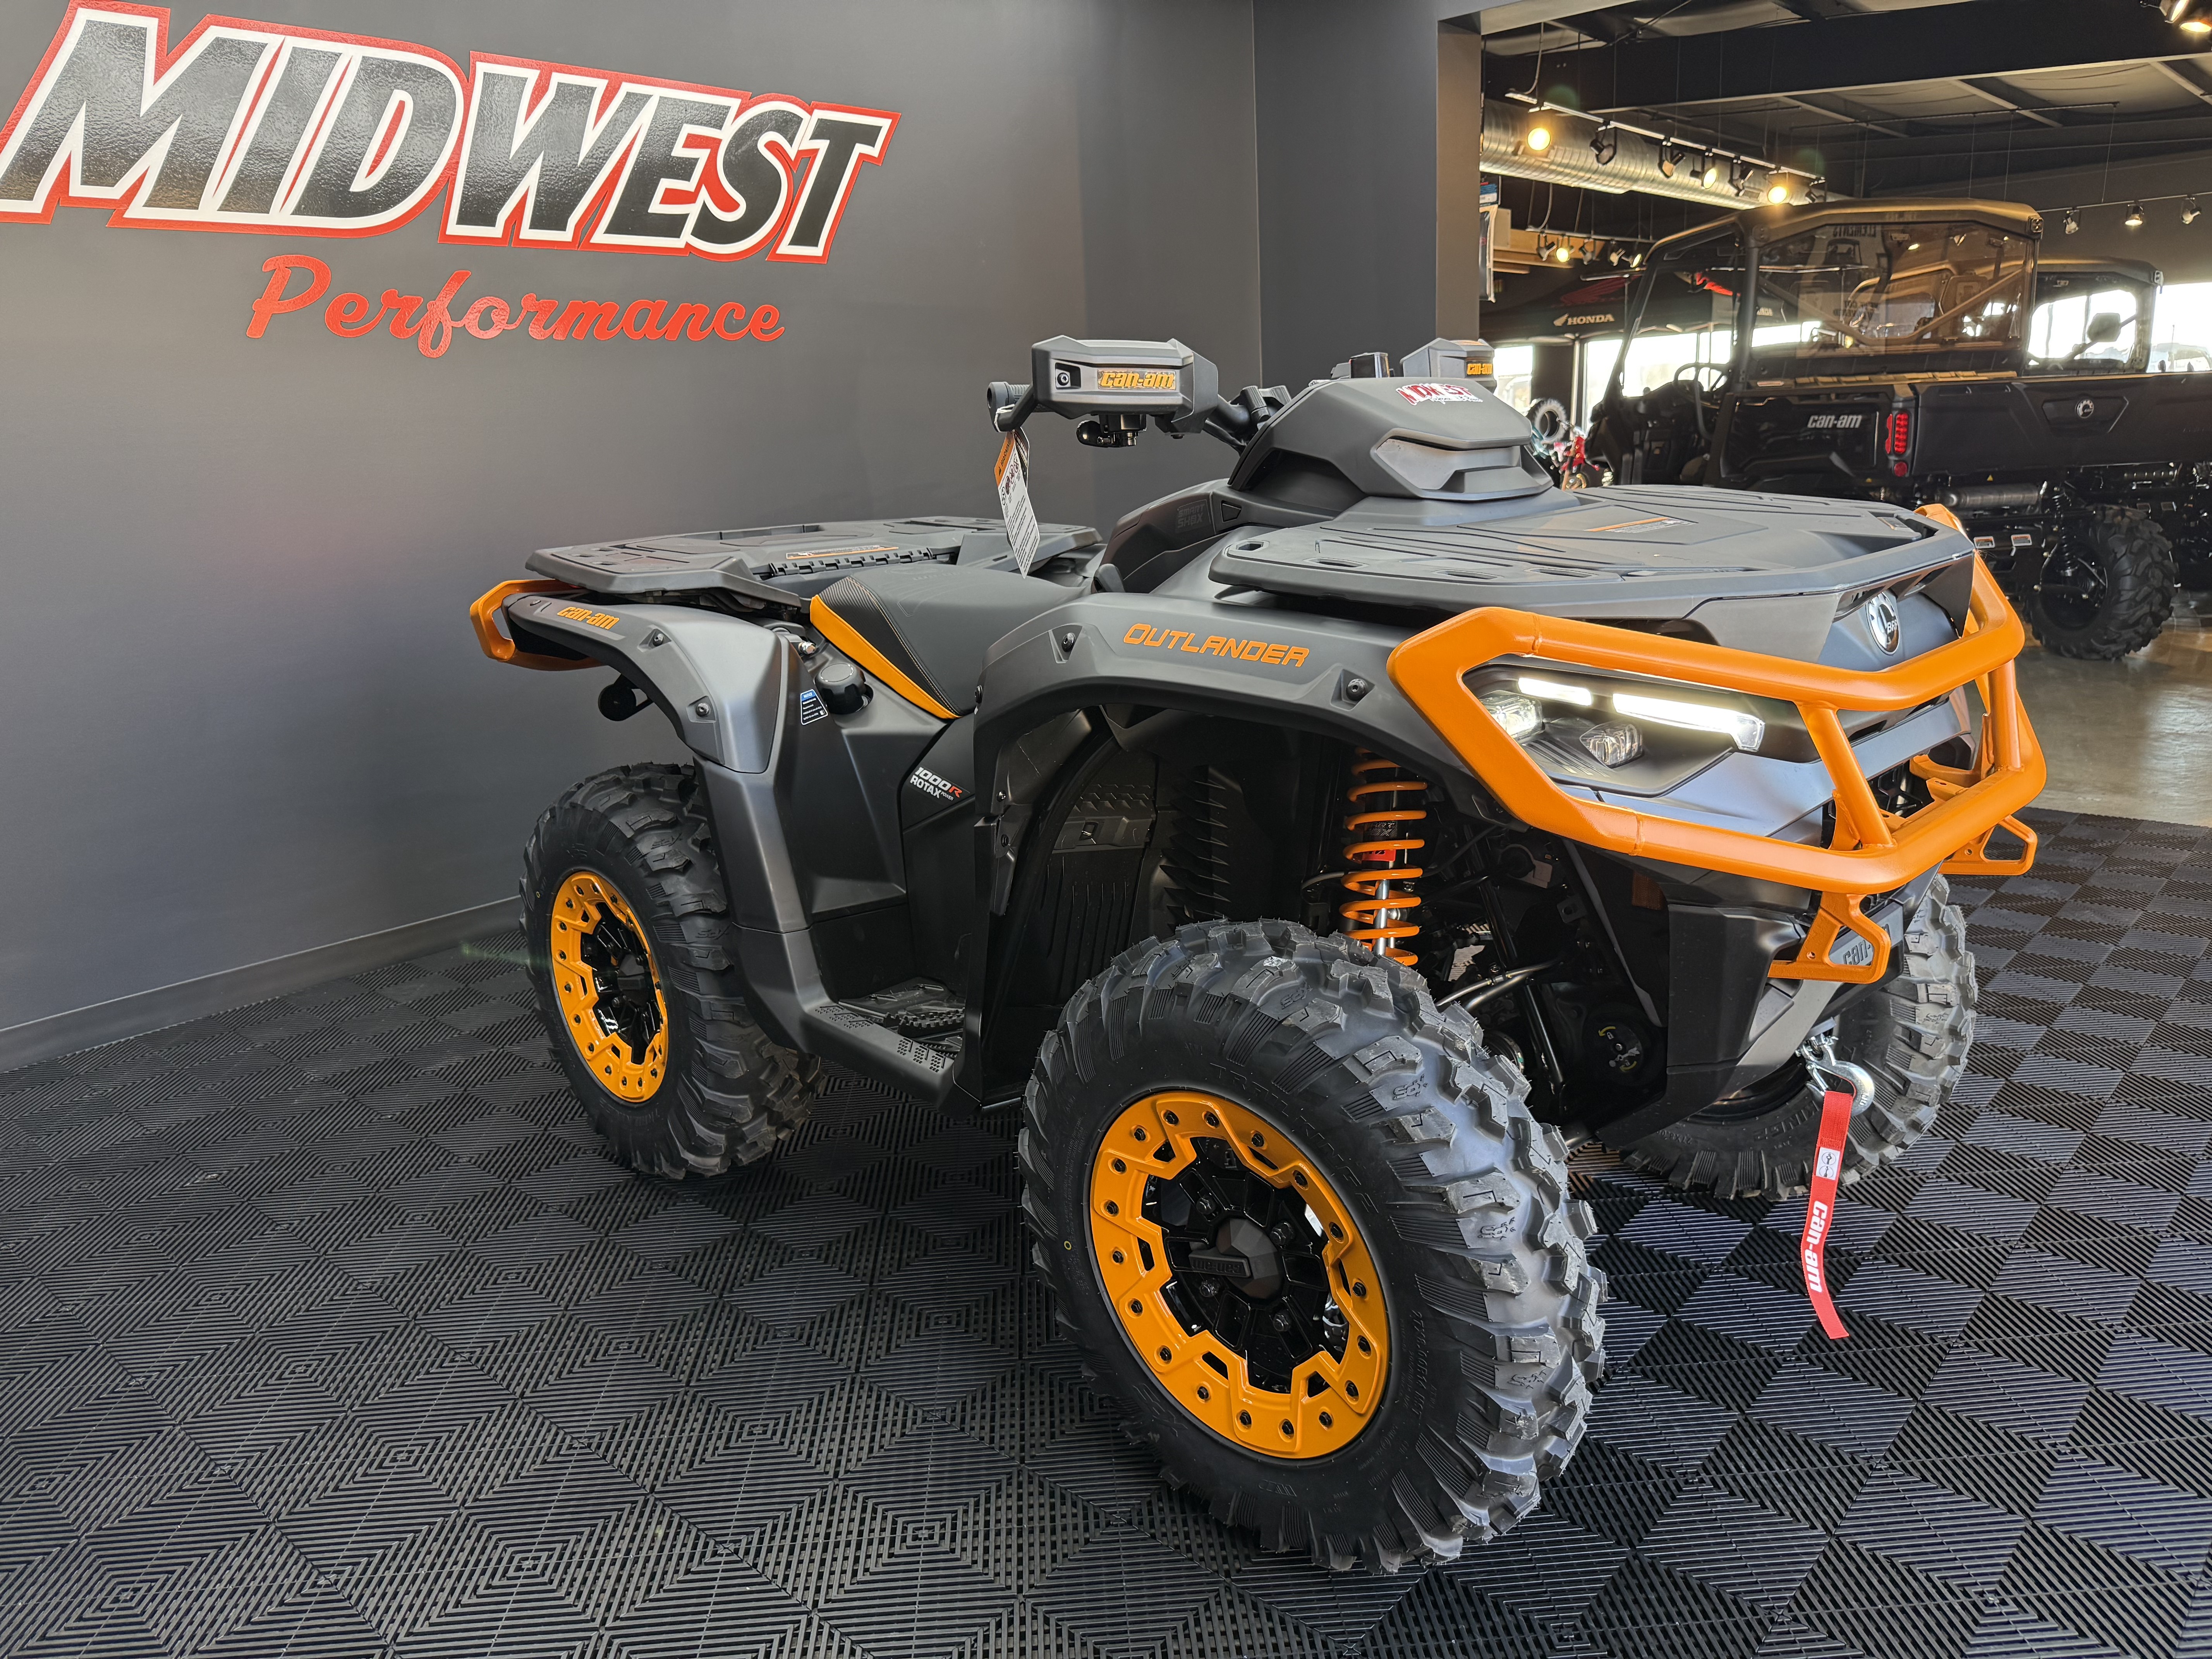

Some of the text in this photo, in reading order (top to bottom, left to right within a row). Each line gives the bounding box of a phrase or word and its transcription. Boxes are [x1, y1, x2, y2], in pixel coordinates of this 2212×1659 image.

[0, 2, 899, 263] MIDWEST
[246, 253, 786, 359] Performance
[1567, 314, 1615, 325] HONDA
[1101, 369, 1175, 389] can-am
[1467, 363, 1493, 375] can-am
[1807, 414, 1862, 428] can-am
[1178, 504, 1205, 517] SMART
[557, 606, 620, 630] can-am
[1887, 620, 1898, 634] BRP
[1123, 623, 1310, 667] OUTLANDER
[910, 775, 954, 801] ROTAX POWER
[915, 767, 963, 798] 1000R
[1804, 1200, 1828, 1293] can-am
[1190, 1257, 1242, 1275] can-am
